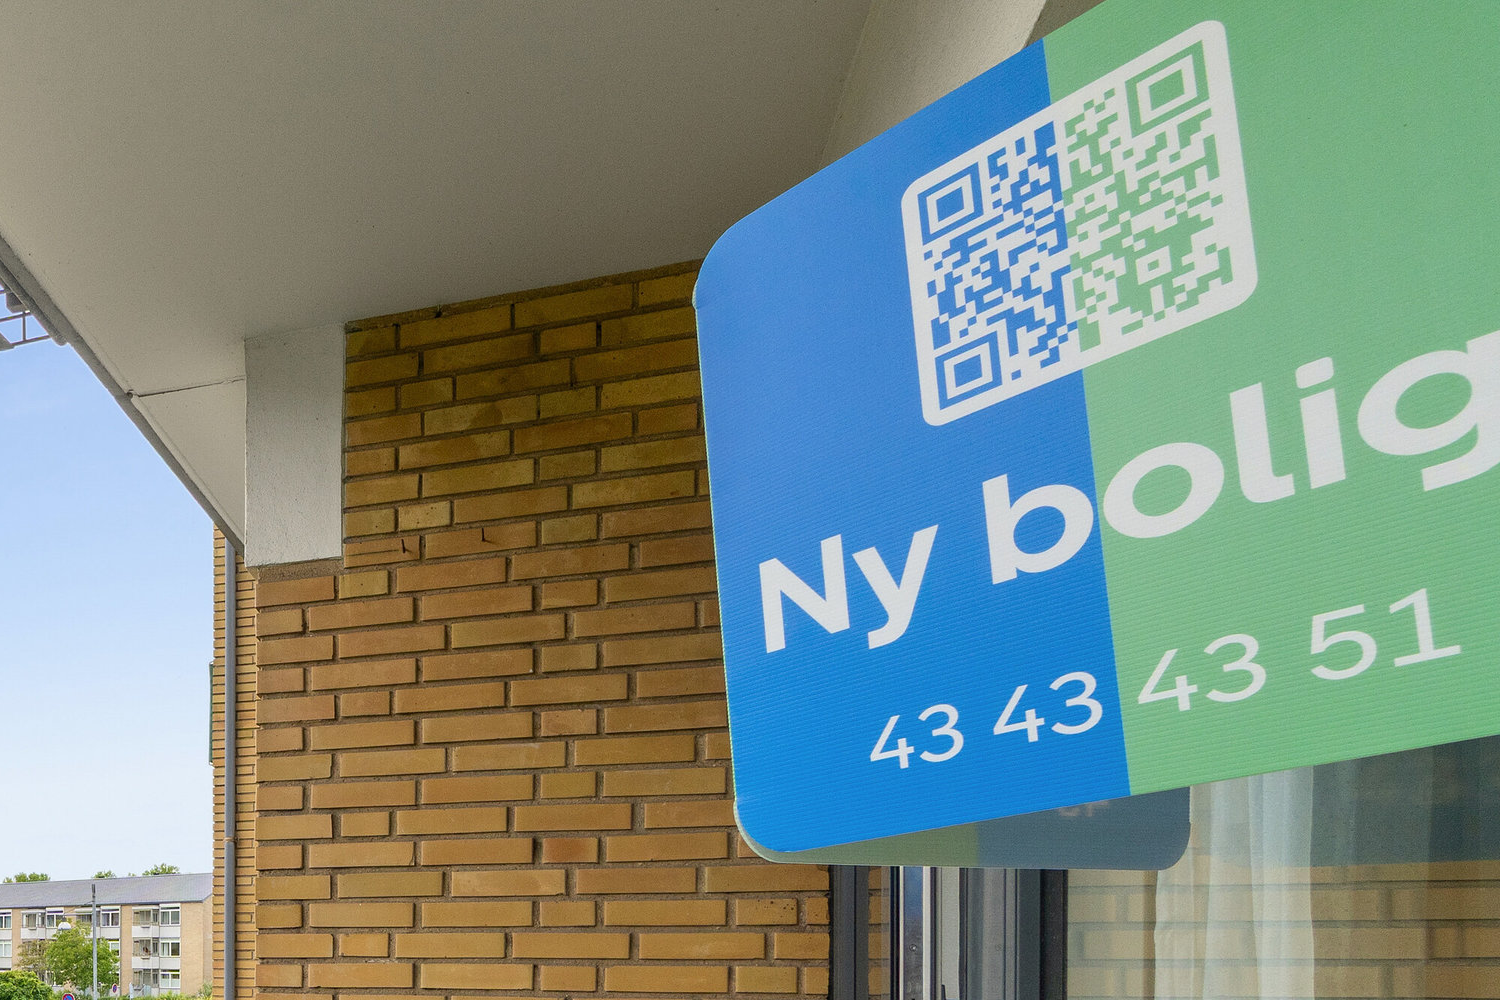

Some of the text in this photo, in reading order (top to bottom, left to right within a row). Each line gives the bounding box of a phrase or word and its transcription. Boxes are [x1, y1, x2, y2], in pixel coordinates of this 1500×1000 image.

[759, 330, 1500, 653] Ny bolig
[869, 588, 1461, 769] 43 43 43 51
